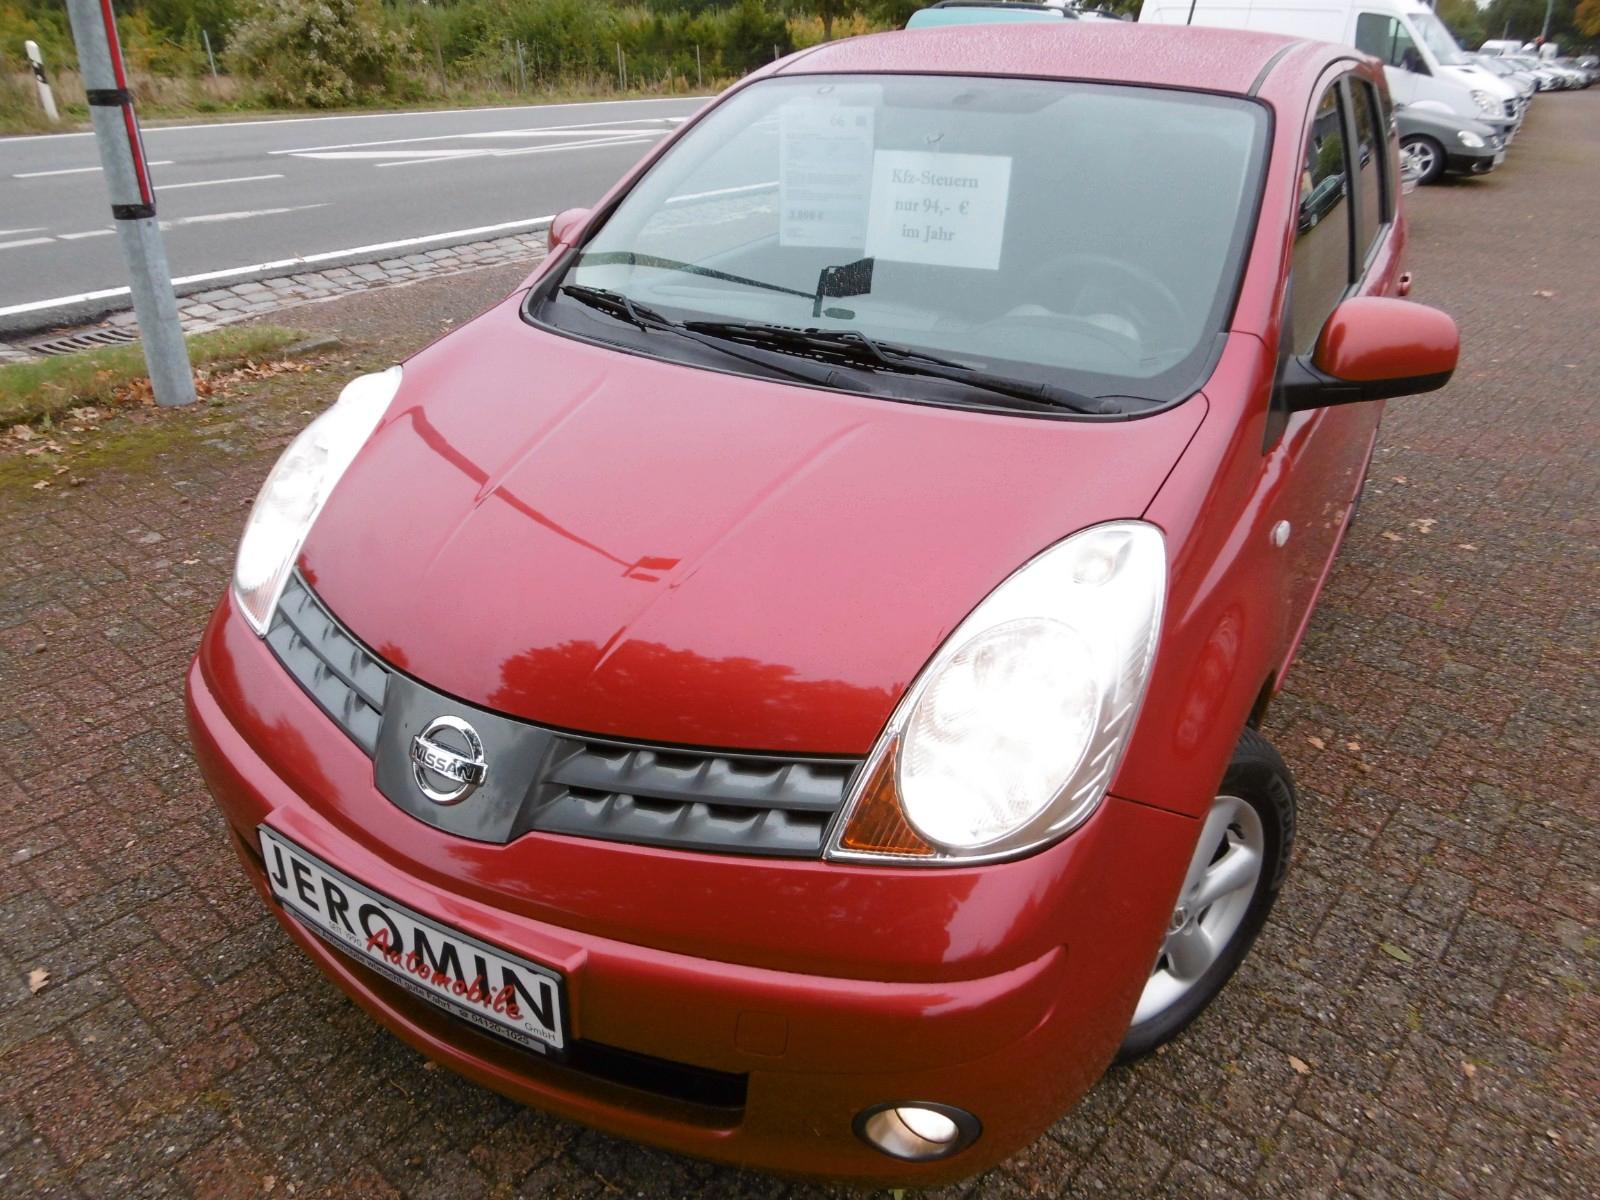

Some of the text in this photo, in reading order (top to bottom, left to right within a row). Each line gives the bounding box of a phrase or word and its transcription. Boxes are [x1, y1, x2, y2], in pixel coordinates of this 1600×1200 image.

[892, 168, 979, 188] Kfz-Steuern
[895, 200, 919, 212] nur
[902, 223, 956, 243] im Jahr
[411, 742, 478, 782] NISSAN
[271, 844, 556, 1032] JEROMIN
[366, 927, 524, 1020] Automobile
[524, 1022, 556, 1041] GmbH
